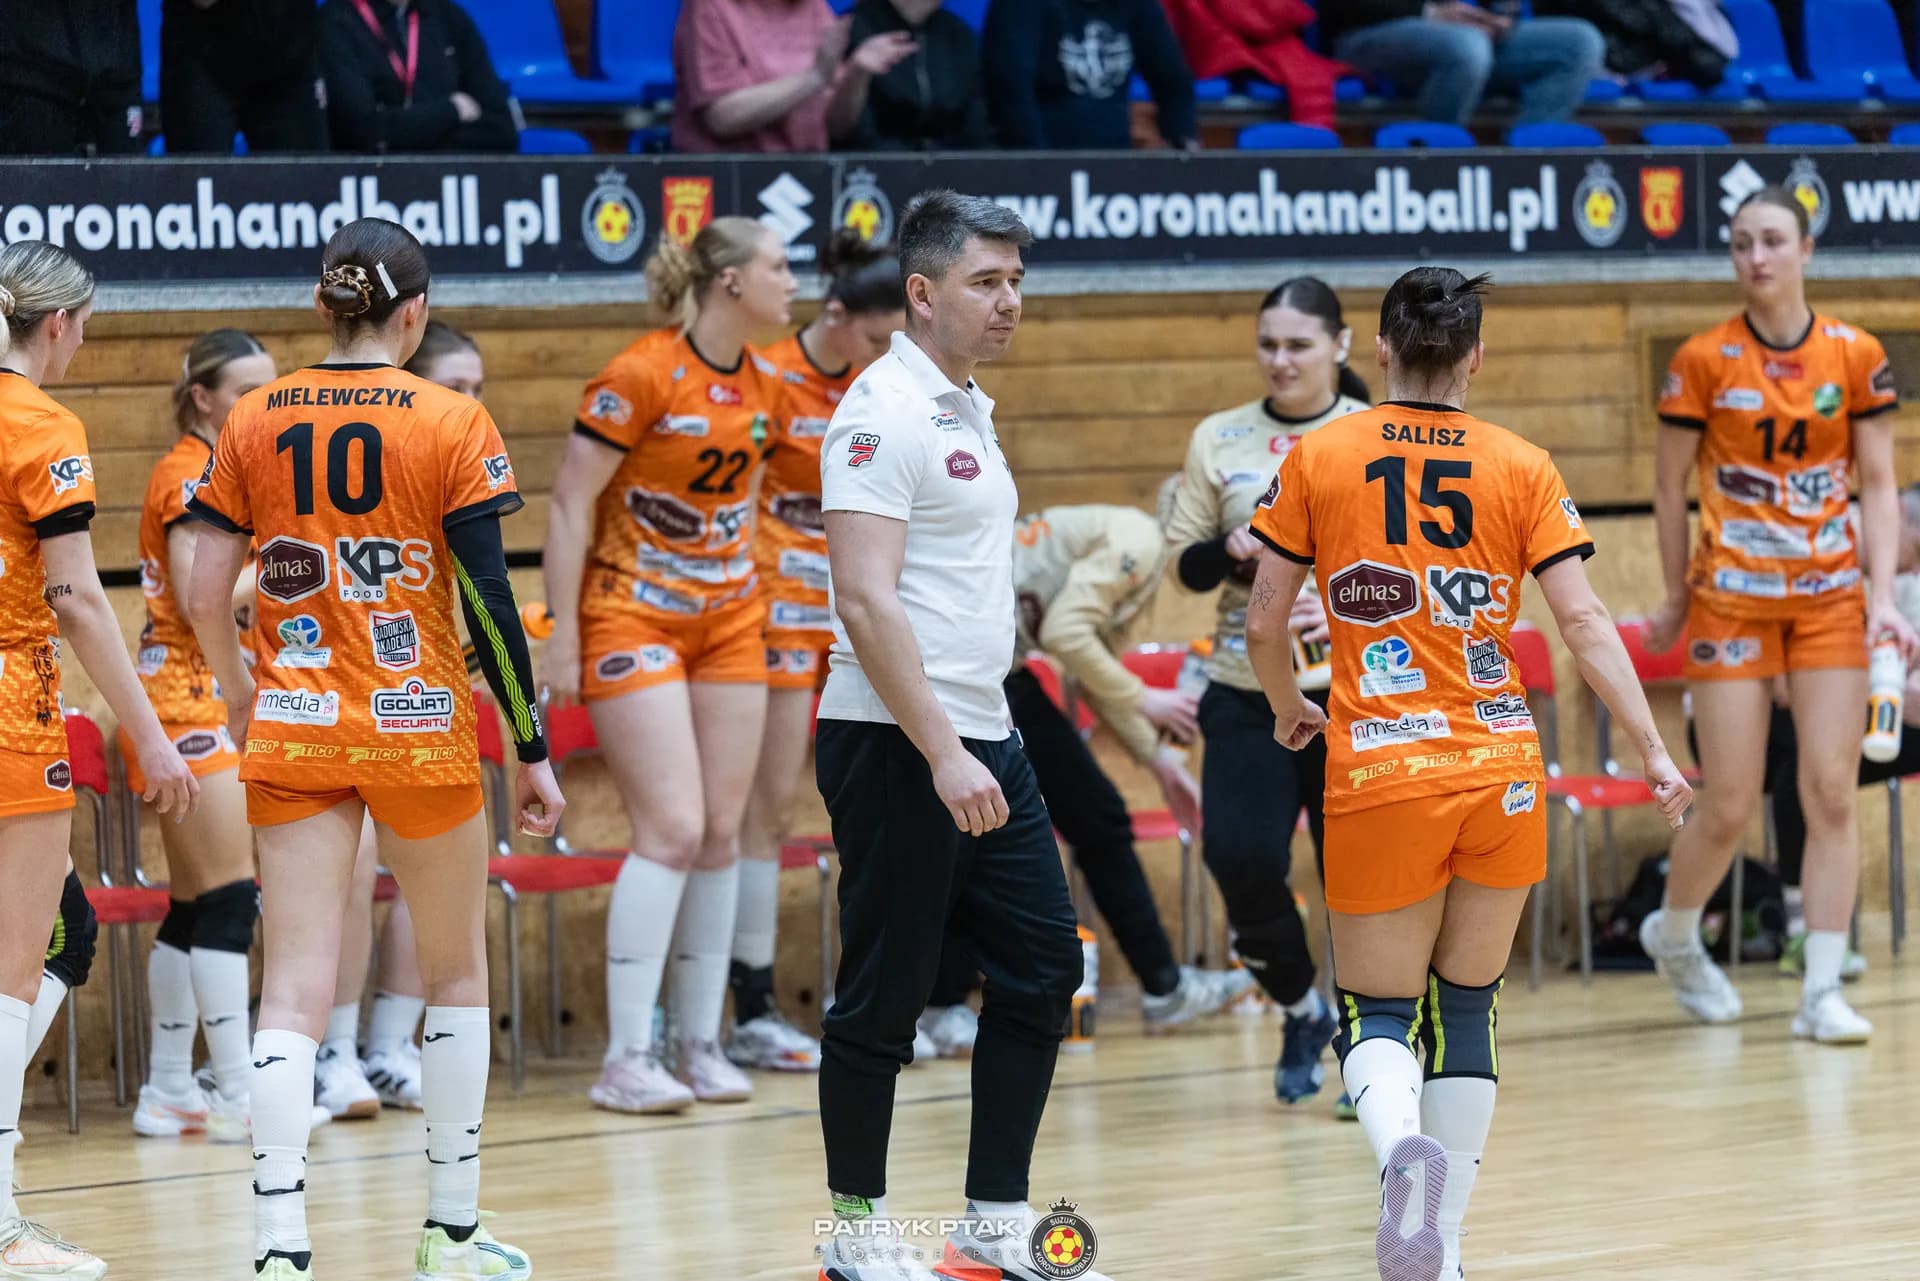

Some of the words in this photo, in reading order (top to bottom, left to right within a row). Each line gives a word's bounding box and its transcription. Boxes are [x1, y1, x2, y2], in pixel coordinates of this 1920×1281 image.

[0, 173, 561, 268] oronahandball.pl
[266, 387, 417, 411] MIELEWCZYK
[853, 434, 879, 445] TICO
[1382, 423, 1466, 447] SALISZ
[1755, 417, 1809, 462] 14
[276, 422, 384, 515] 10
[688, 448, 749, 493] 22
[1366, 456, 1473, 549] 15
[339, 541, 430, 587] KPS
[51, 584, 72, 599] 974
[344, 589, 384, 599] FOOD
[1339, 579, 1401, 603] elmas
[1430, 570, 1511, 619] KPS
[374, 617, 415, 641] RADOMSKA
[381, 698, 448, 711] GOLIAT
[381, 717, 449, 729] SECURITY
[251, 740, 275, 753] TICO
[303, 745, 336, 757] TICO
[367, 748, 400, 760] TICO
[429, 746, 455, 759] TICO
[1365, 762, 1394, 778] TICO
[1426, 753, 1457, 766] TICO
[1488, 744, 1515, 757] TICO
[52, 768, 70, 780] elma
